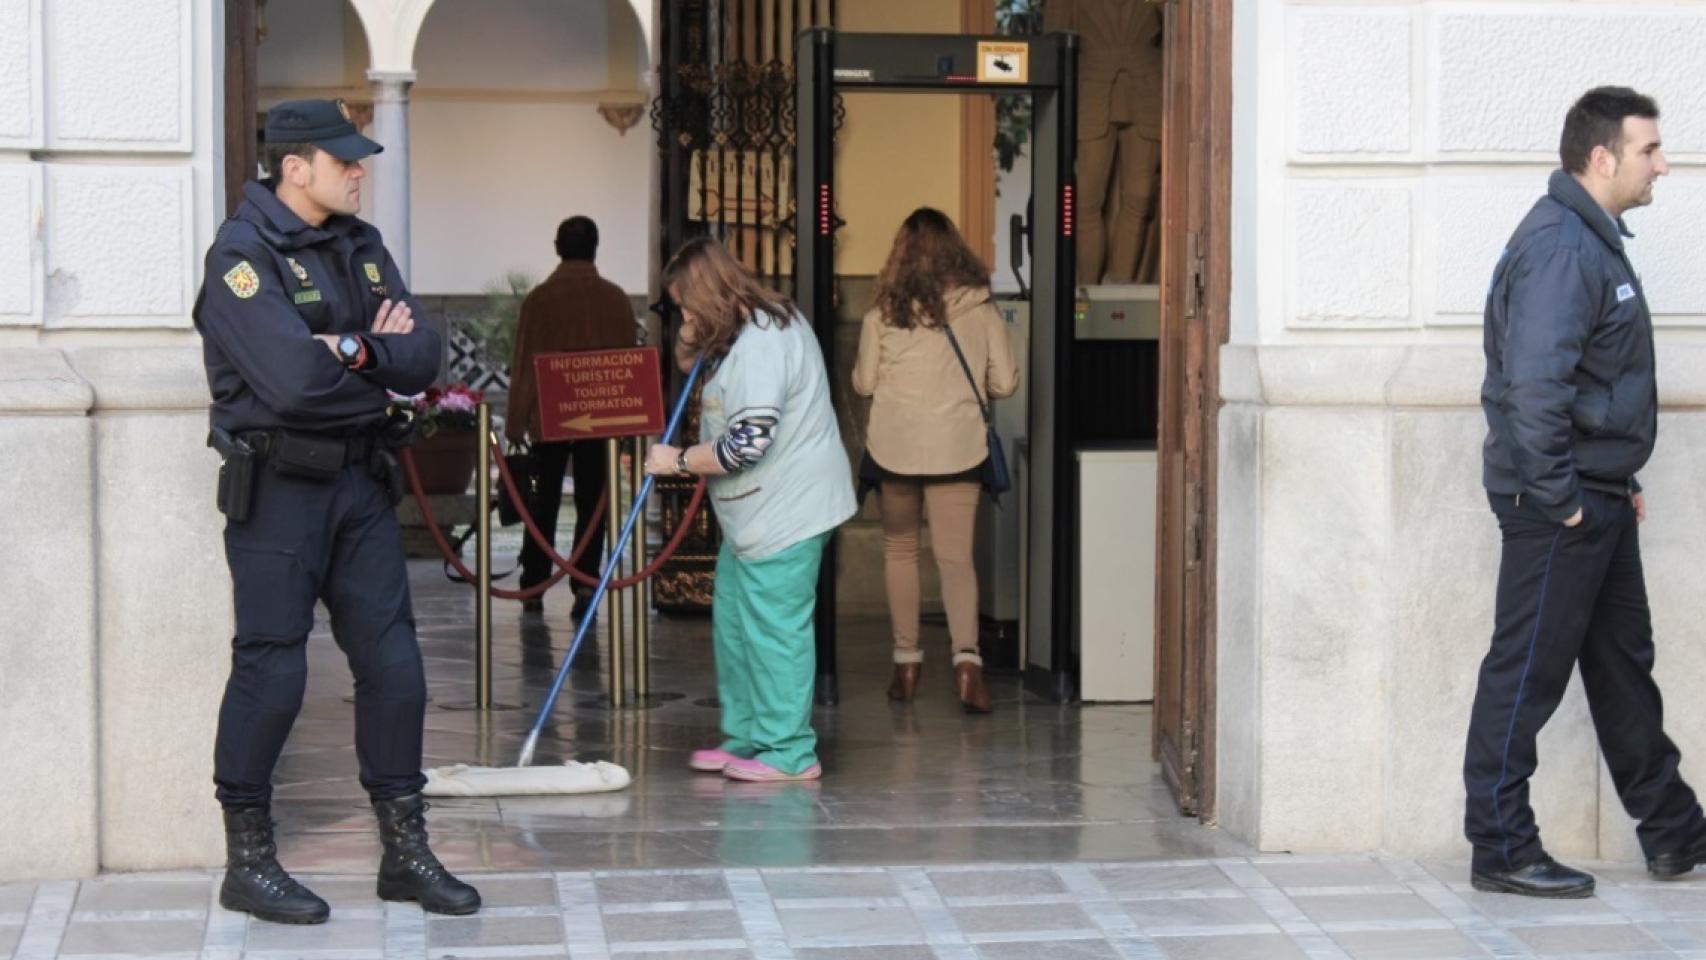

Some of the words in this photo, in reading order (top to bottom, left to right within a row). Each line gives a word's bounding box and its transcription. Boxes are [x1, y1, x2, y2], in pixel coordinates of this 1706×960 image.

[550, 352, 643, 370] INFORMACIÓN
[564, 368, 633, 383] TURÍSTICA
[574, 385, 625, 398] TOURIST
[559, 398, 643, 412] INFORMATION
